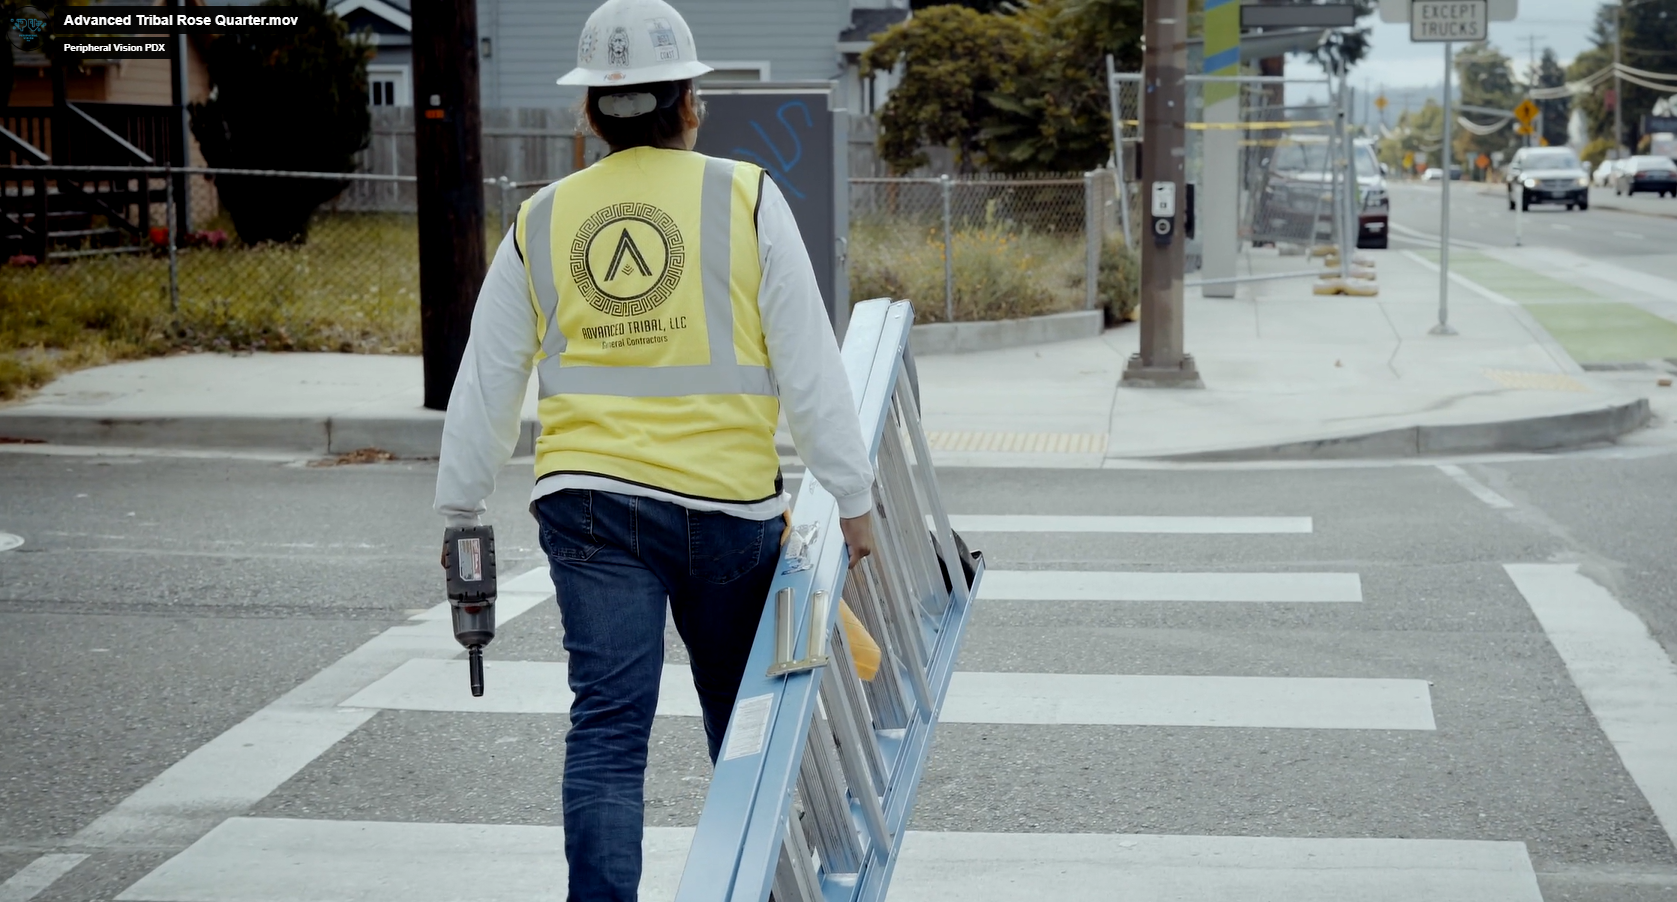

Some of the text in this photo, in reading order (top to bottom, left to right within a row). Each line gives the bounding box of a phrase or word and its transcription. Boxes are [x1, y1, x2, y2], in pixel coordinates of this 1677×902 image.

[1422, 4, 1476, 19] EXCEPT
[1421, 21, 1478, 36] TRUCKS
[581, 315, 687, 339] ADVANCED TRIBAL, LLC
[626, 335, 669, 347] Contractors
